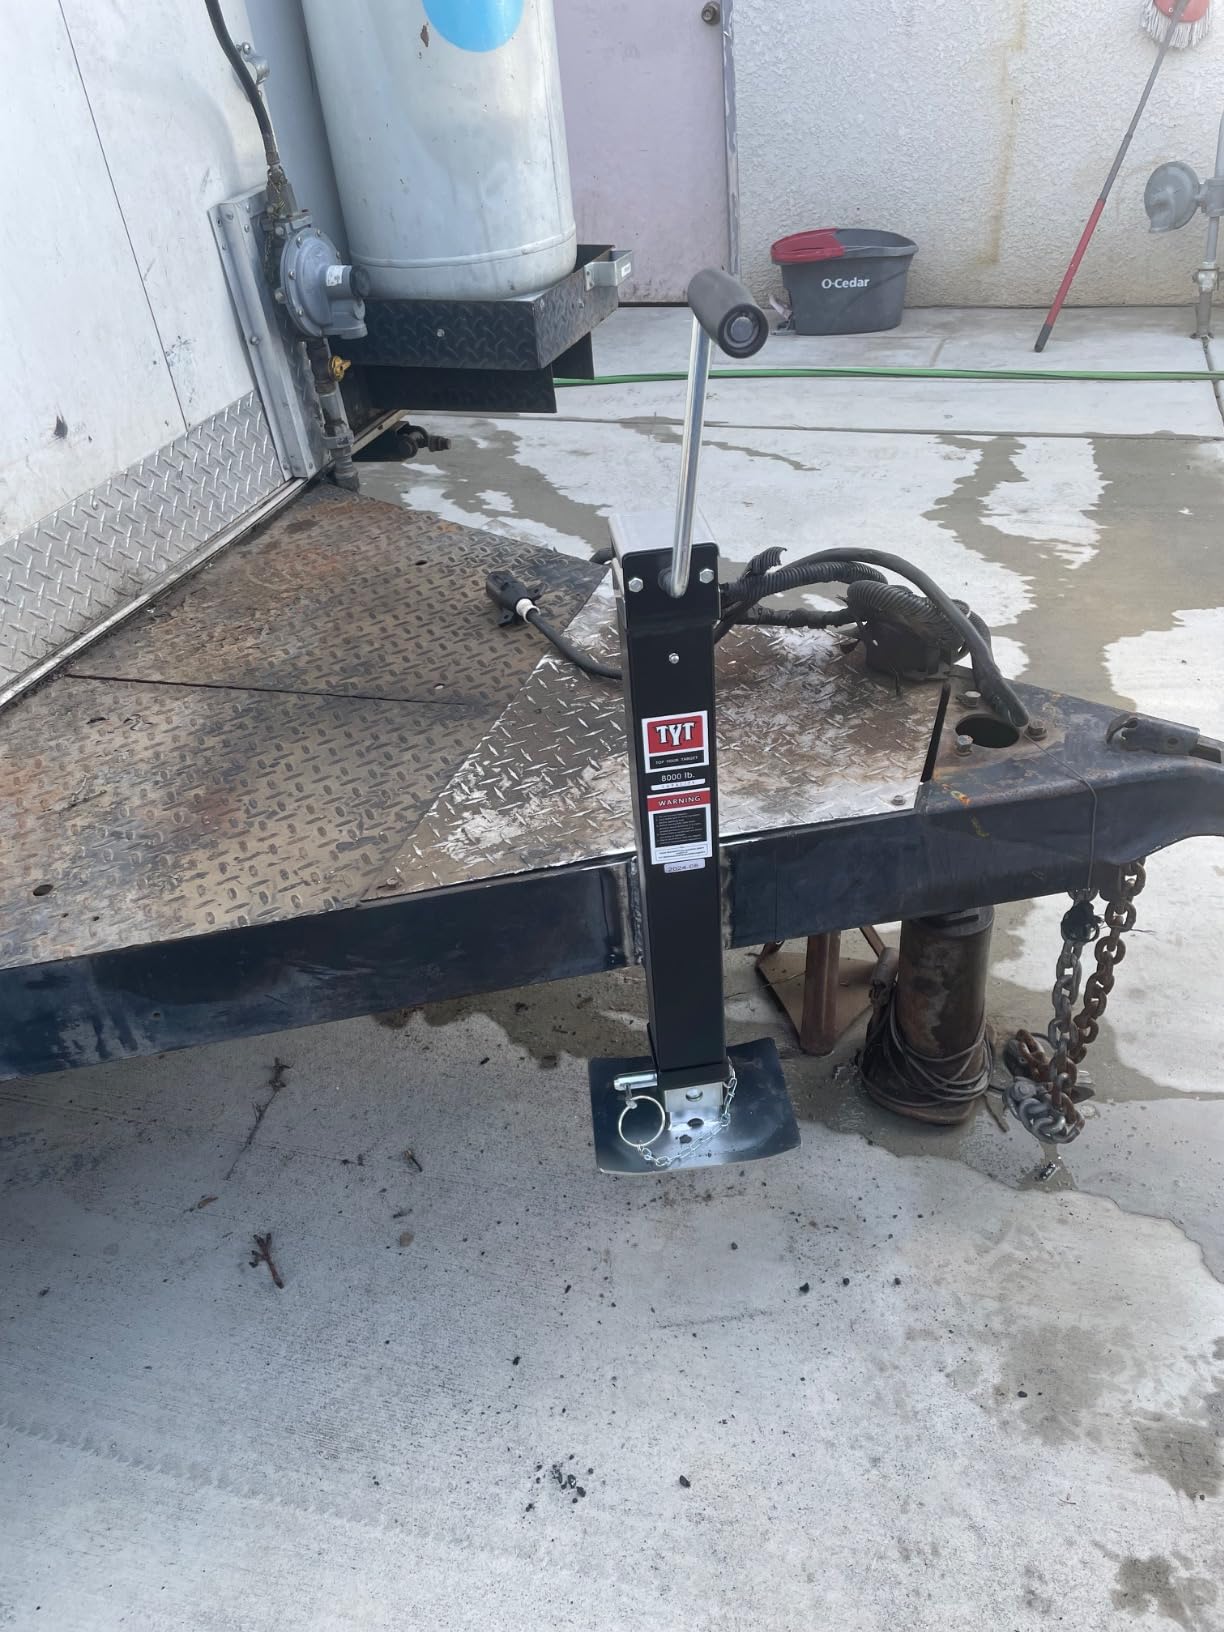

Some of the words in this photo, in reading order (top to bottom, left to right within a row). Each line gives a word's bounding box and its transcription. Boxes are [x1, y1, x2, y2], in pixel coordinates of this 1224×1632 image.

[656, 722, 695, 746] TYT
[661, 773, 682, 782] 8000
[658, 796, 701, 807] WARNING
